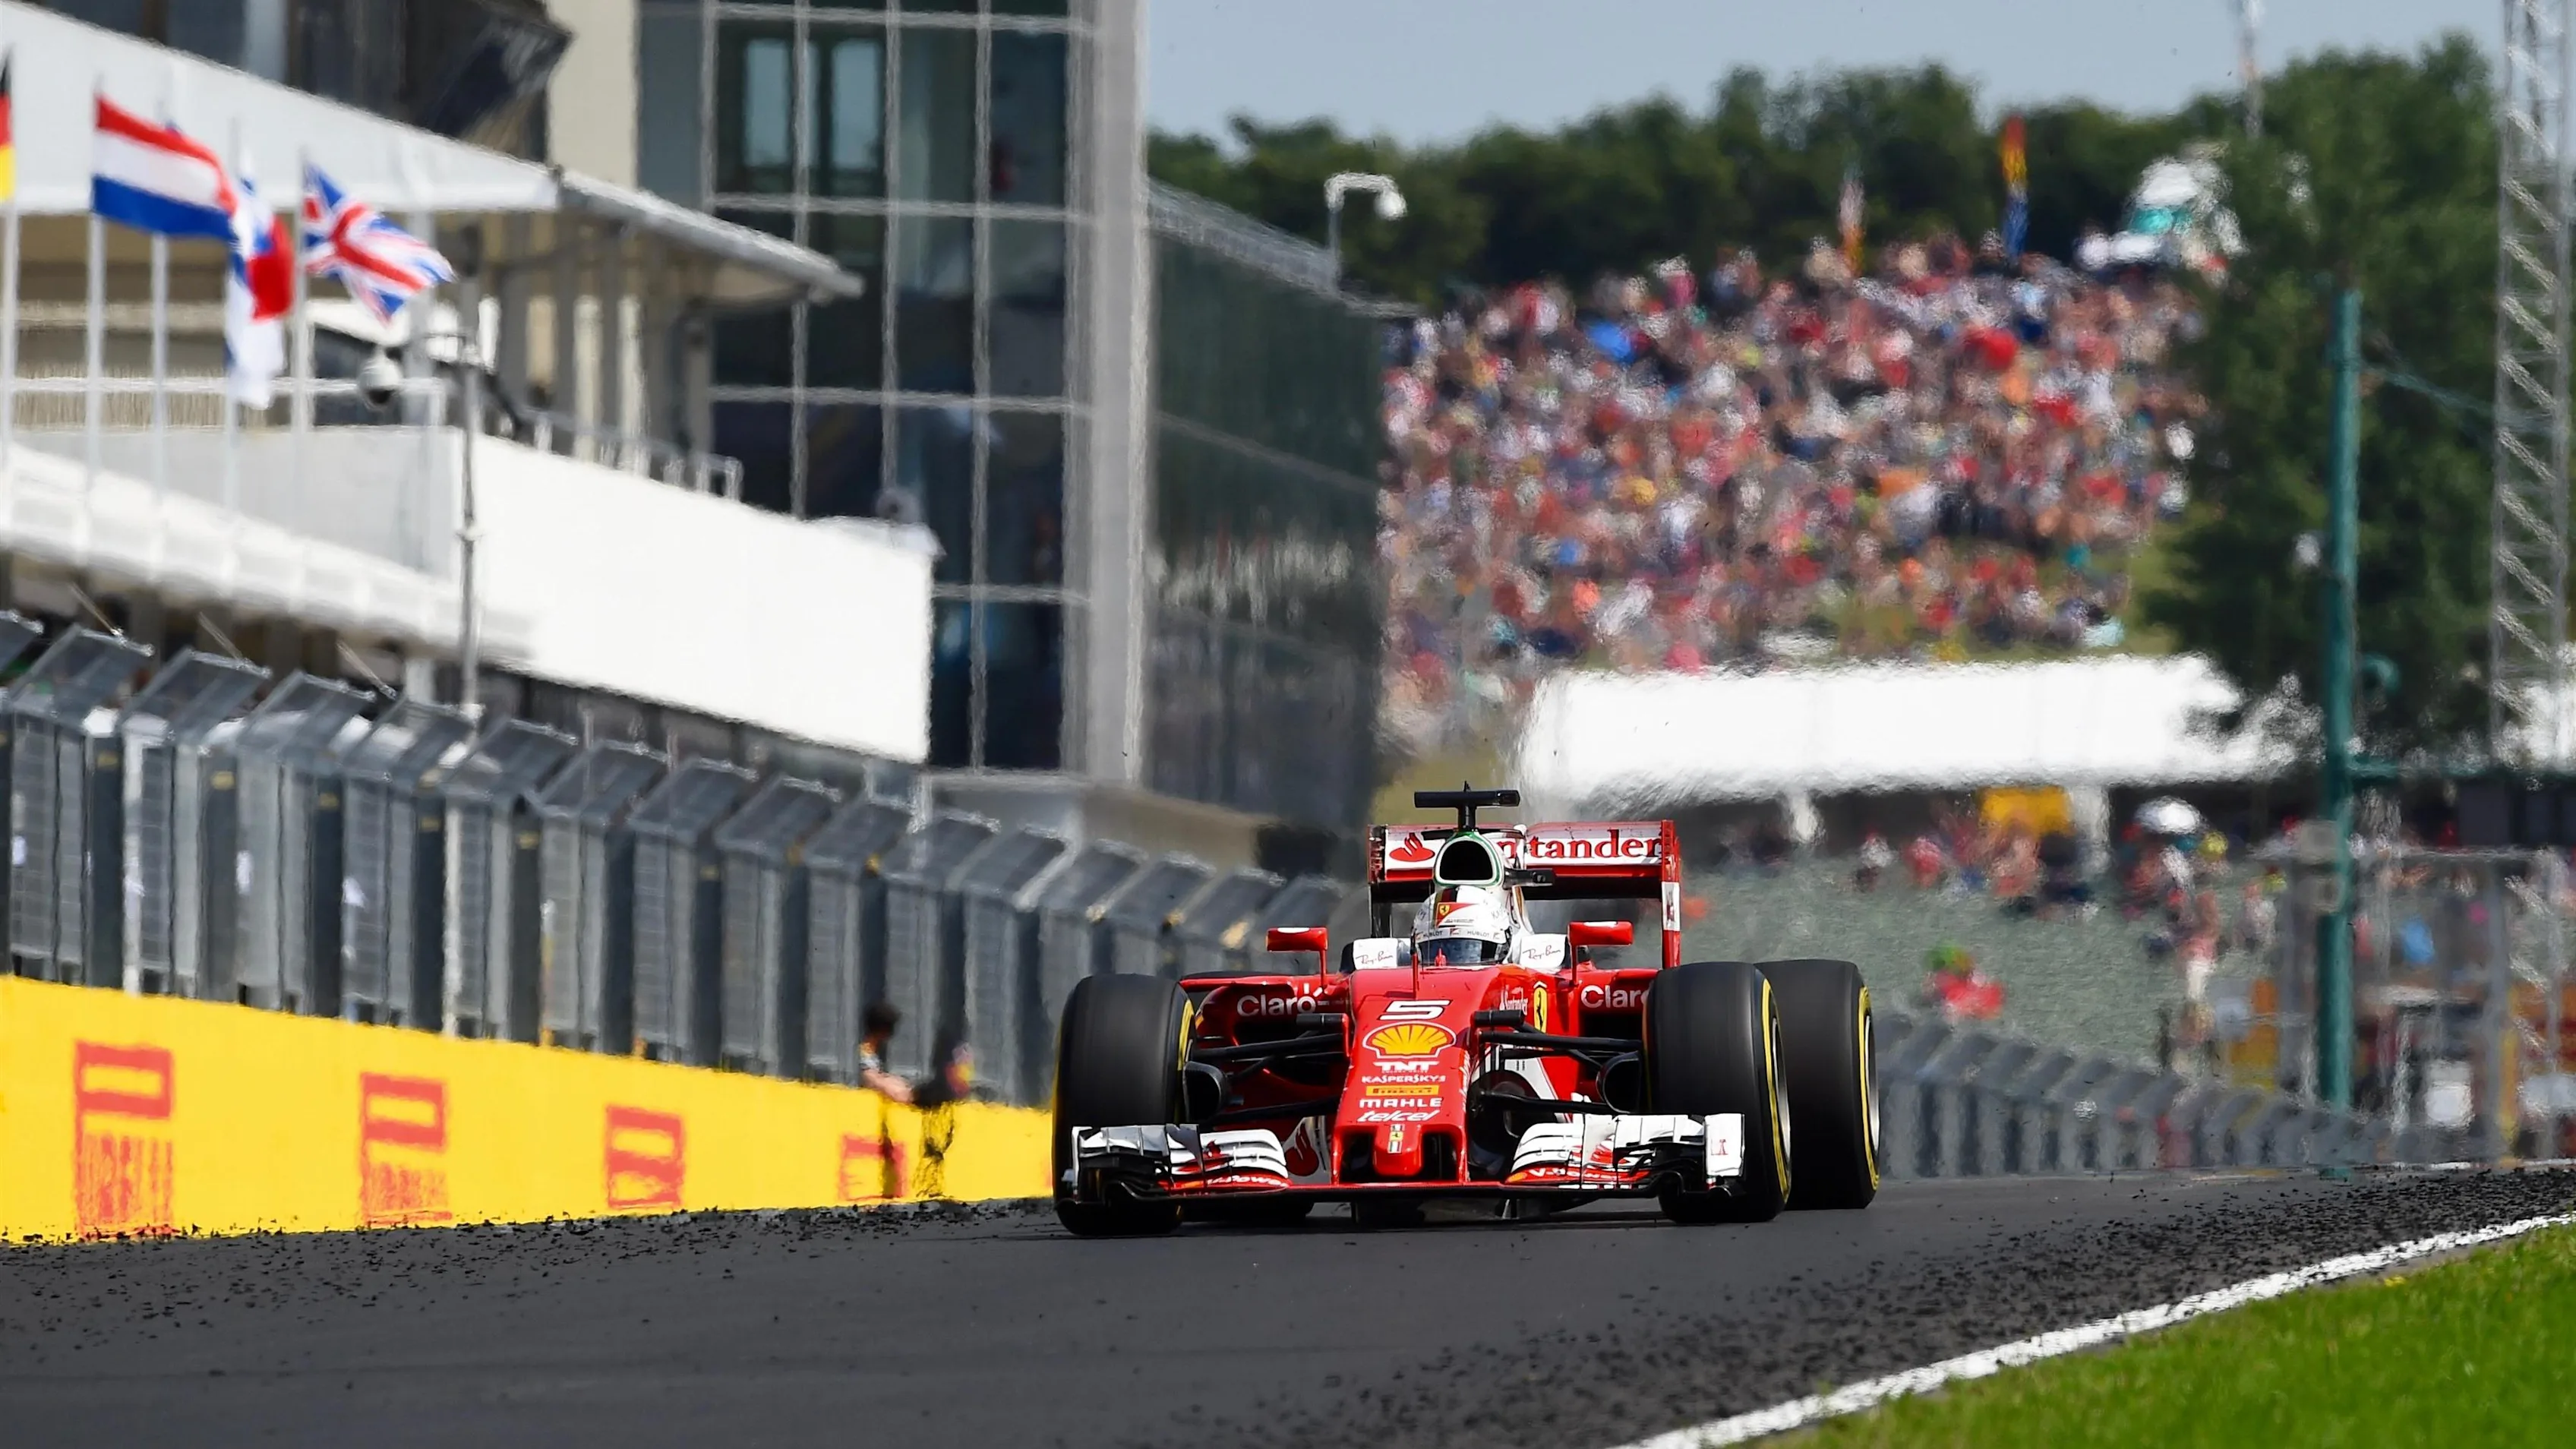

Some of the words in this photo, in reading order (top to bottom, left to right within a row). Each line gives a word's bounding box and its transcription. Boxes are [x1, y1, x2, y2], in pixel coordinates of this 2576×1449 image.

[1496, 829, 1662, 858] ntander
[1237, 994, 1316, 1017] Claro
[1378, 999, 1452, 1020] 5
[1373, 1061, 1440, 1072] TNT
[1362, 1075, 1438, 1084] KASPERSKY
[1359, 1097, 1442, 1108] MAHLE
[1357, 1110, 1441, 1122] telcel
